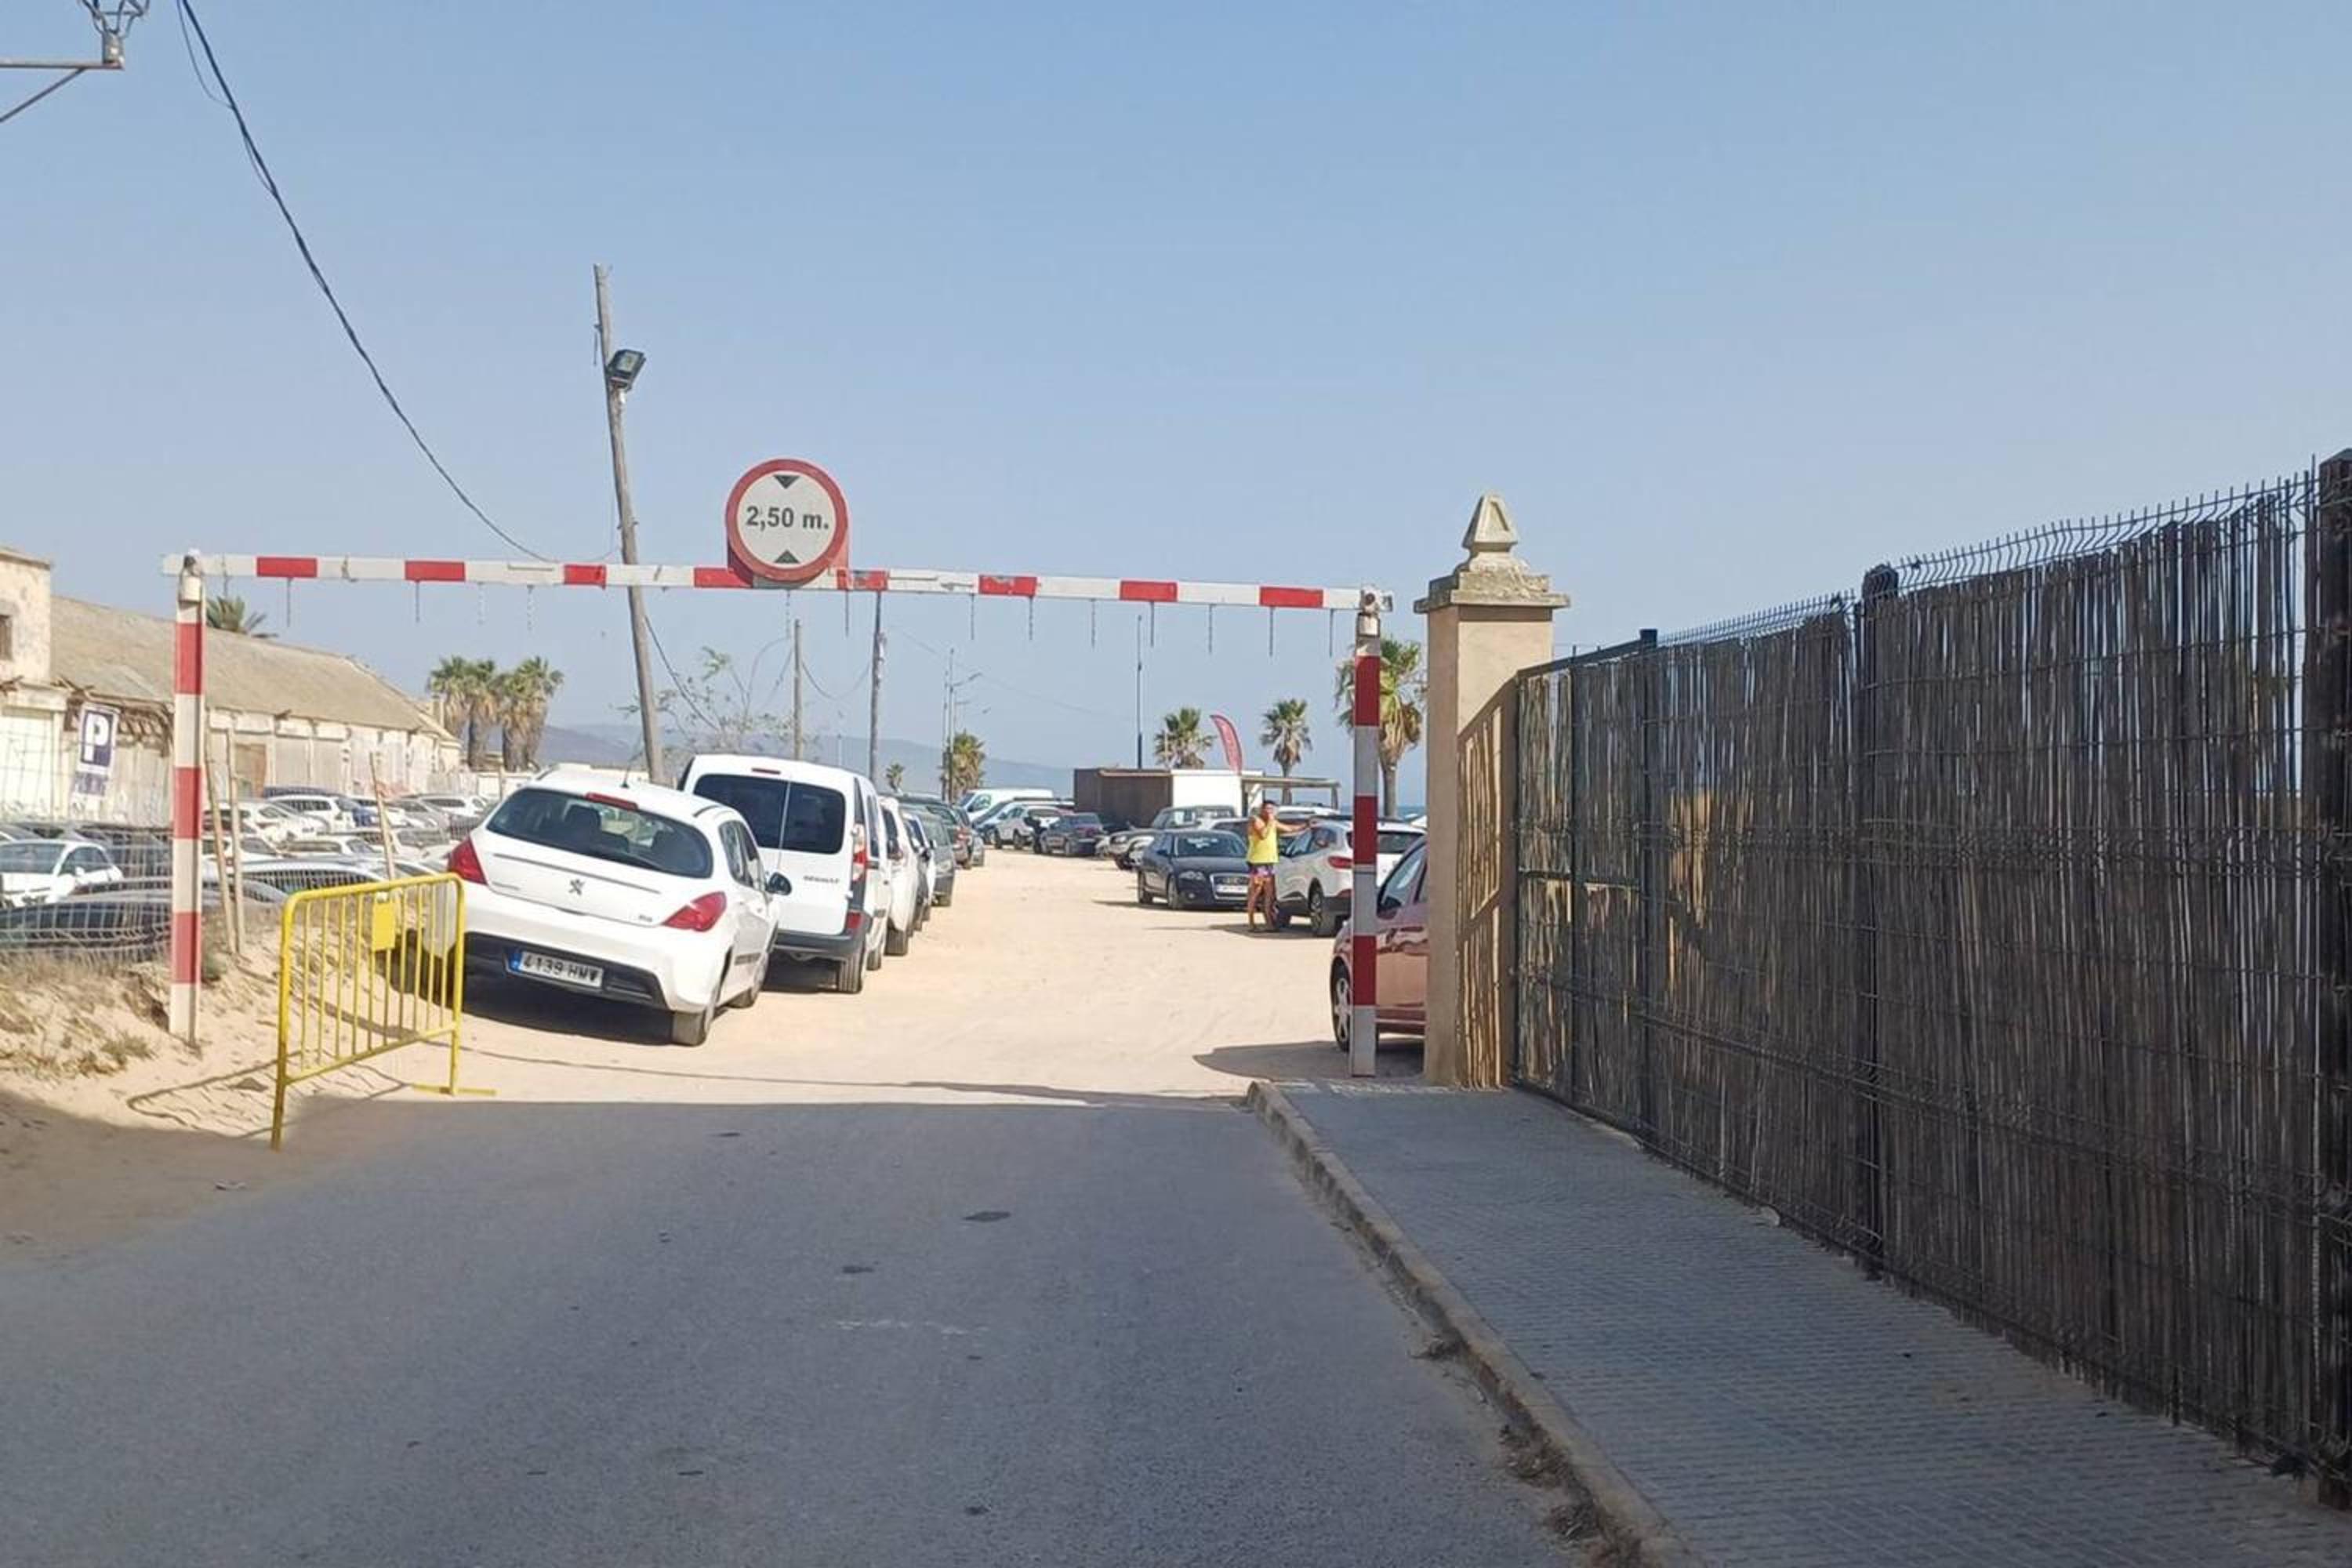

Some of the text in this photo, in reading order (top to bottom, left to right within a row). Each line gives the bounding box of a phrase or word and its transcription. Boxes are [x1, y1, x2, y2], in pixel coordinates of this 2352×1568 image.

[746, 506, 829, 532] 2,50 m.
[84, 714, 109, 762] P
